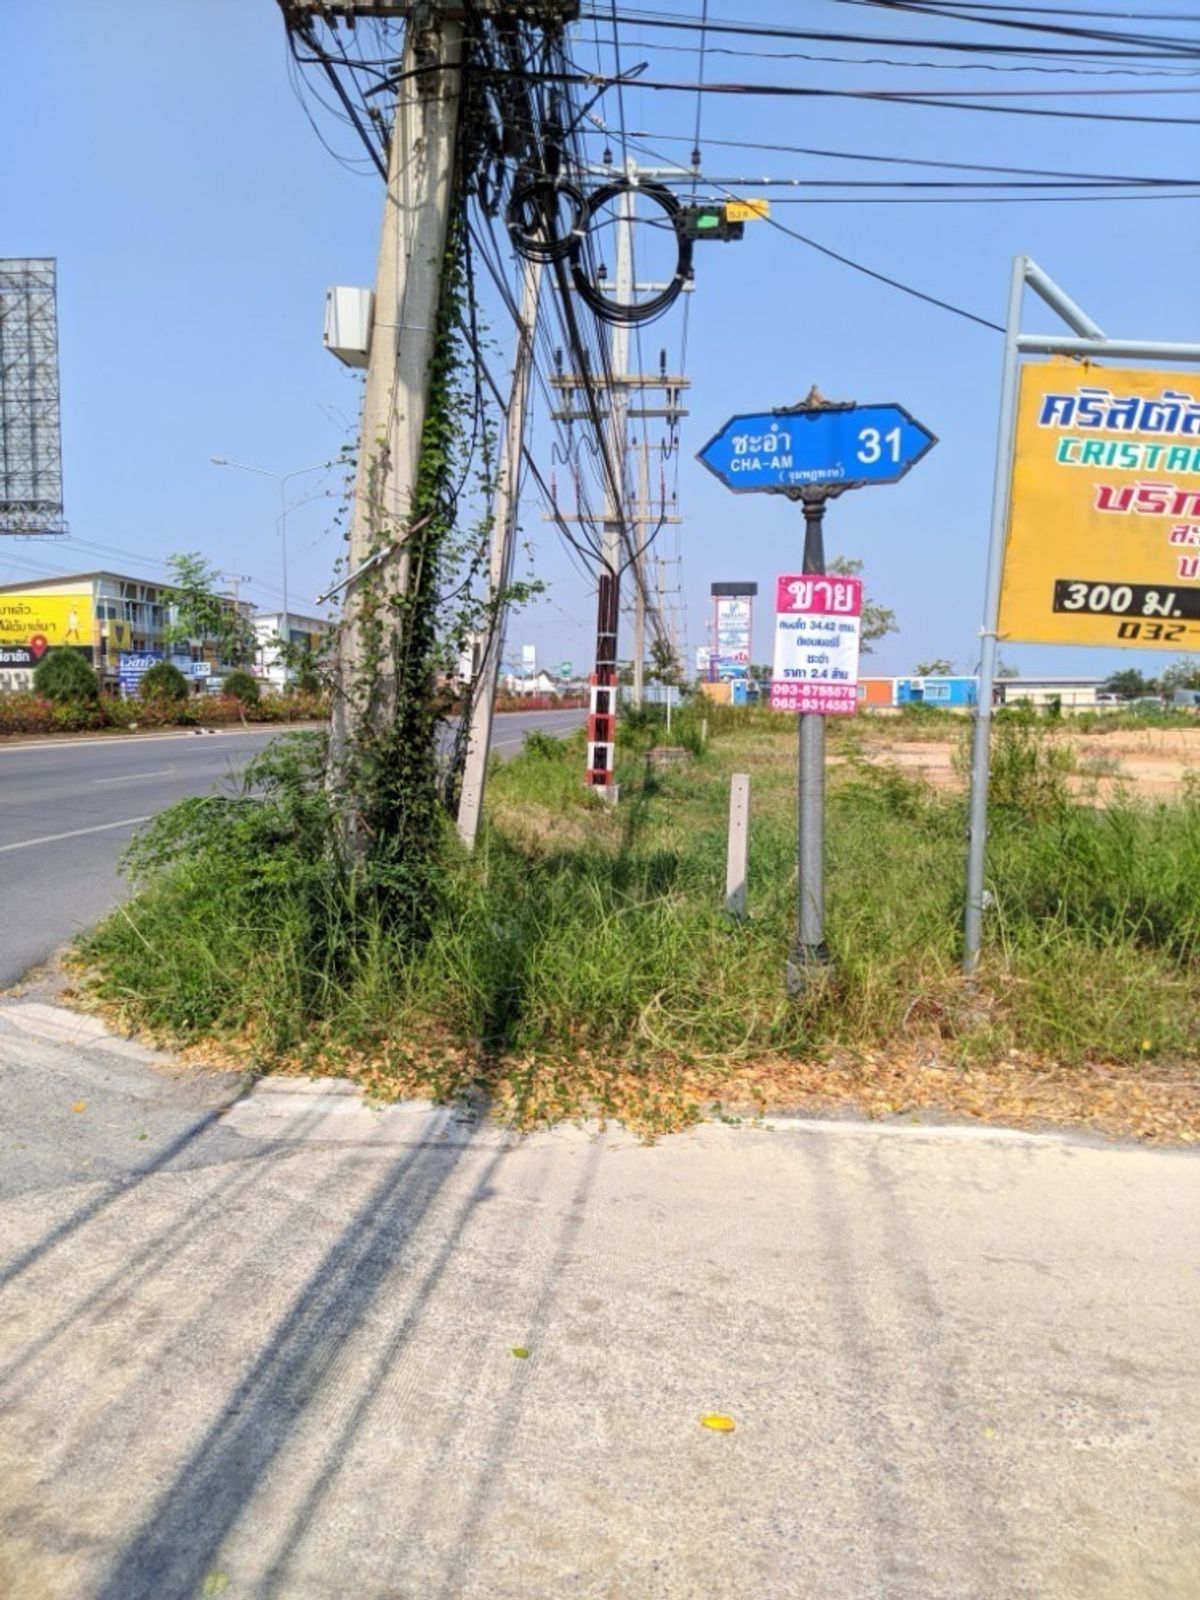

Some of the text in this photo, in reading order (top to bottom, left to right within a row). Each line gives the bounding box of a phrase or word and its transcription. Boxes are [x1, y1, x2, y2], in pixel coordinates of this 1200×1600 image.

[732, 423, 901, 464] ชะอำ 31
[731, 455, 793, 473] CHA-AM
[787, 581, 854, 612] ขาย
[1063, 583, 1183, 618] 300 ม.
[811, 668, 828, 679] 2.4
